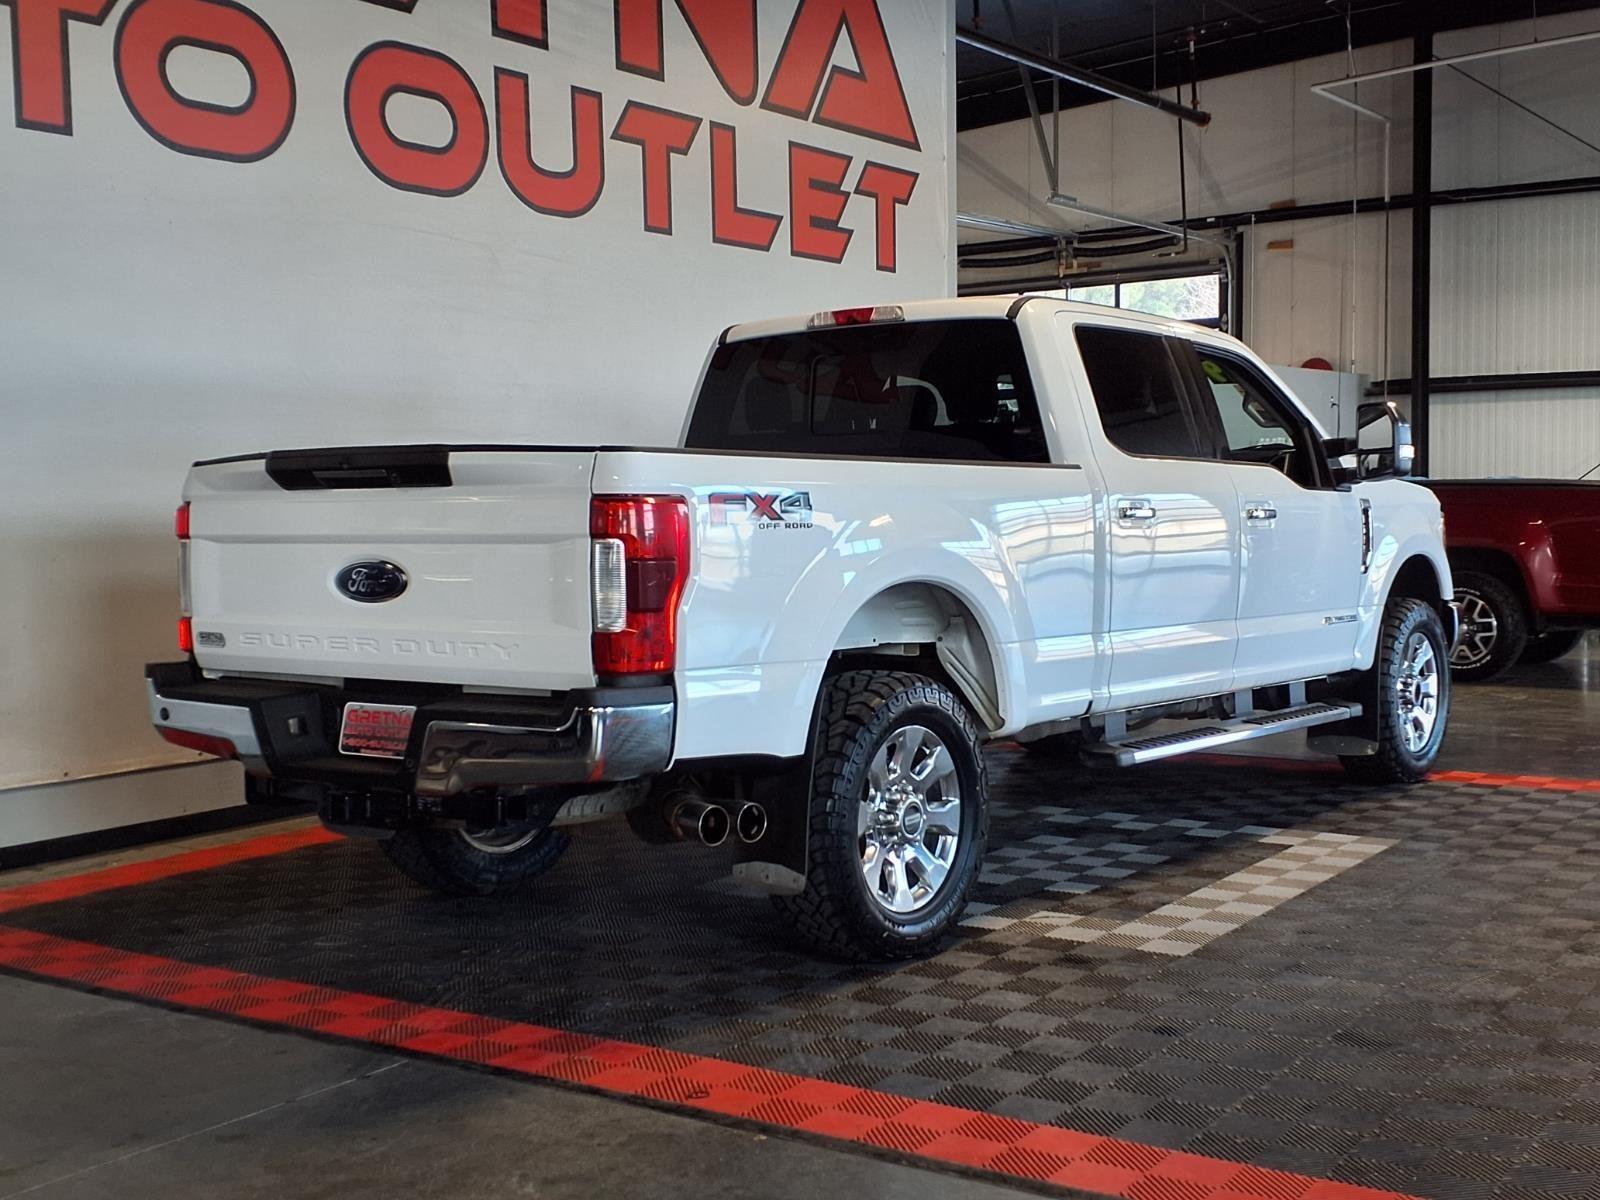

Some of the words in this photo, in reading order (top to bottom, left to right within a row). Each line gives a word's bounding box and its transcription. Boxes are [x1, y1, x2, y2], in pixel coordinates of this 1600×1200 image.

[344, 40, 920, 273] OUTLET
[707, 491, 813, 527] FX4
[758, 522, 782, 530] OFF
[784, 522, 813, 530] ROAD
[347, 567, 394, 592] Fo
[239, 632, 381, 654] SUPER
[391, 638, 519, 660] DUTY
[346, 709, 411, 727] GRETNA
